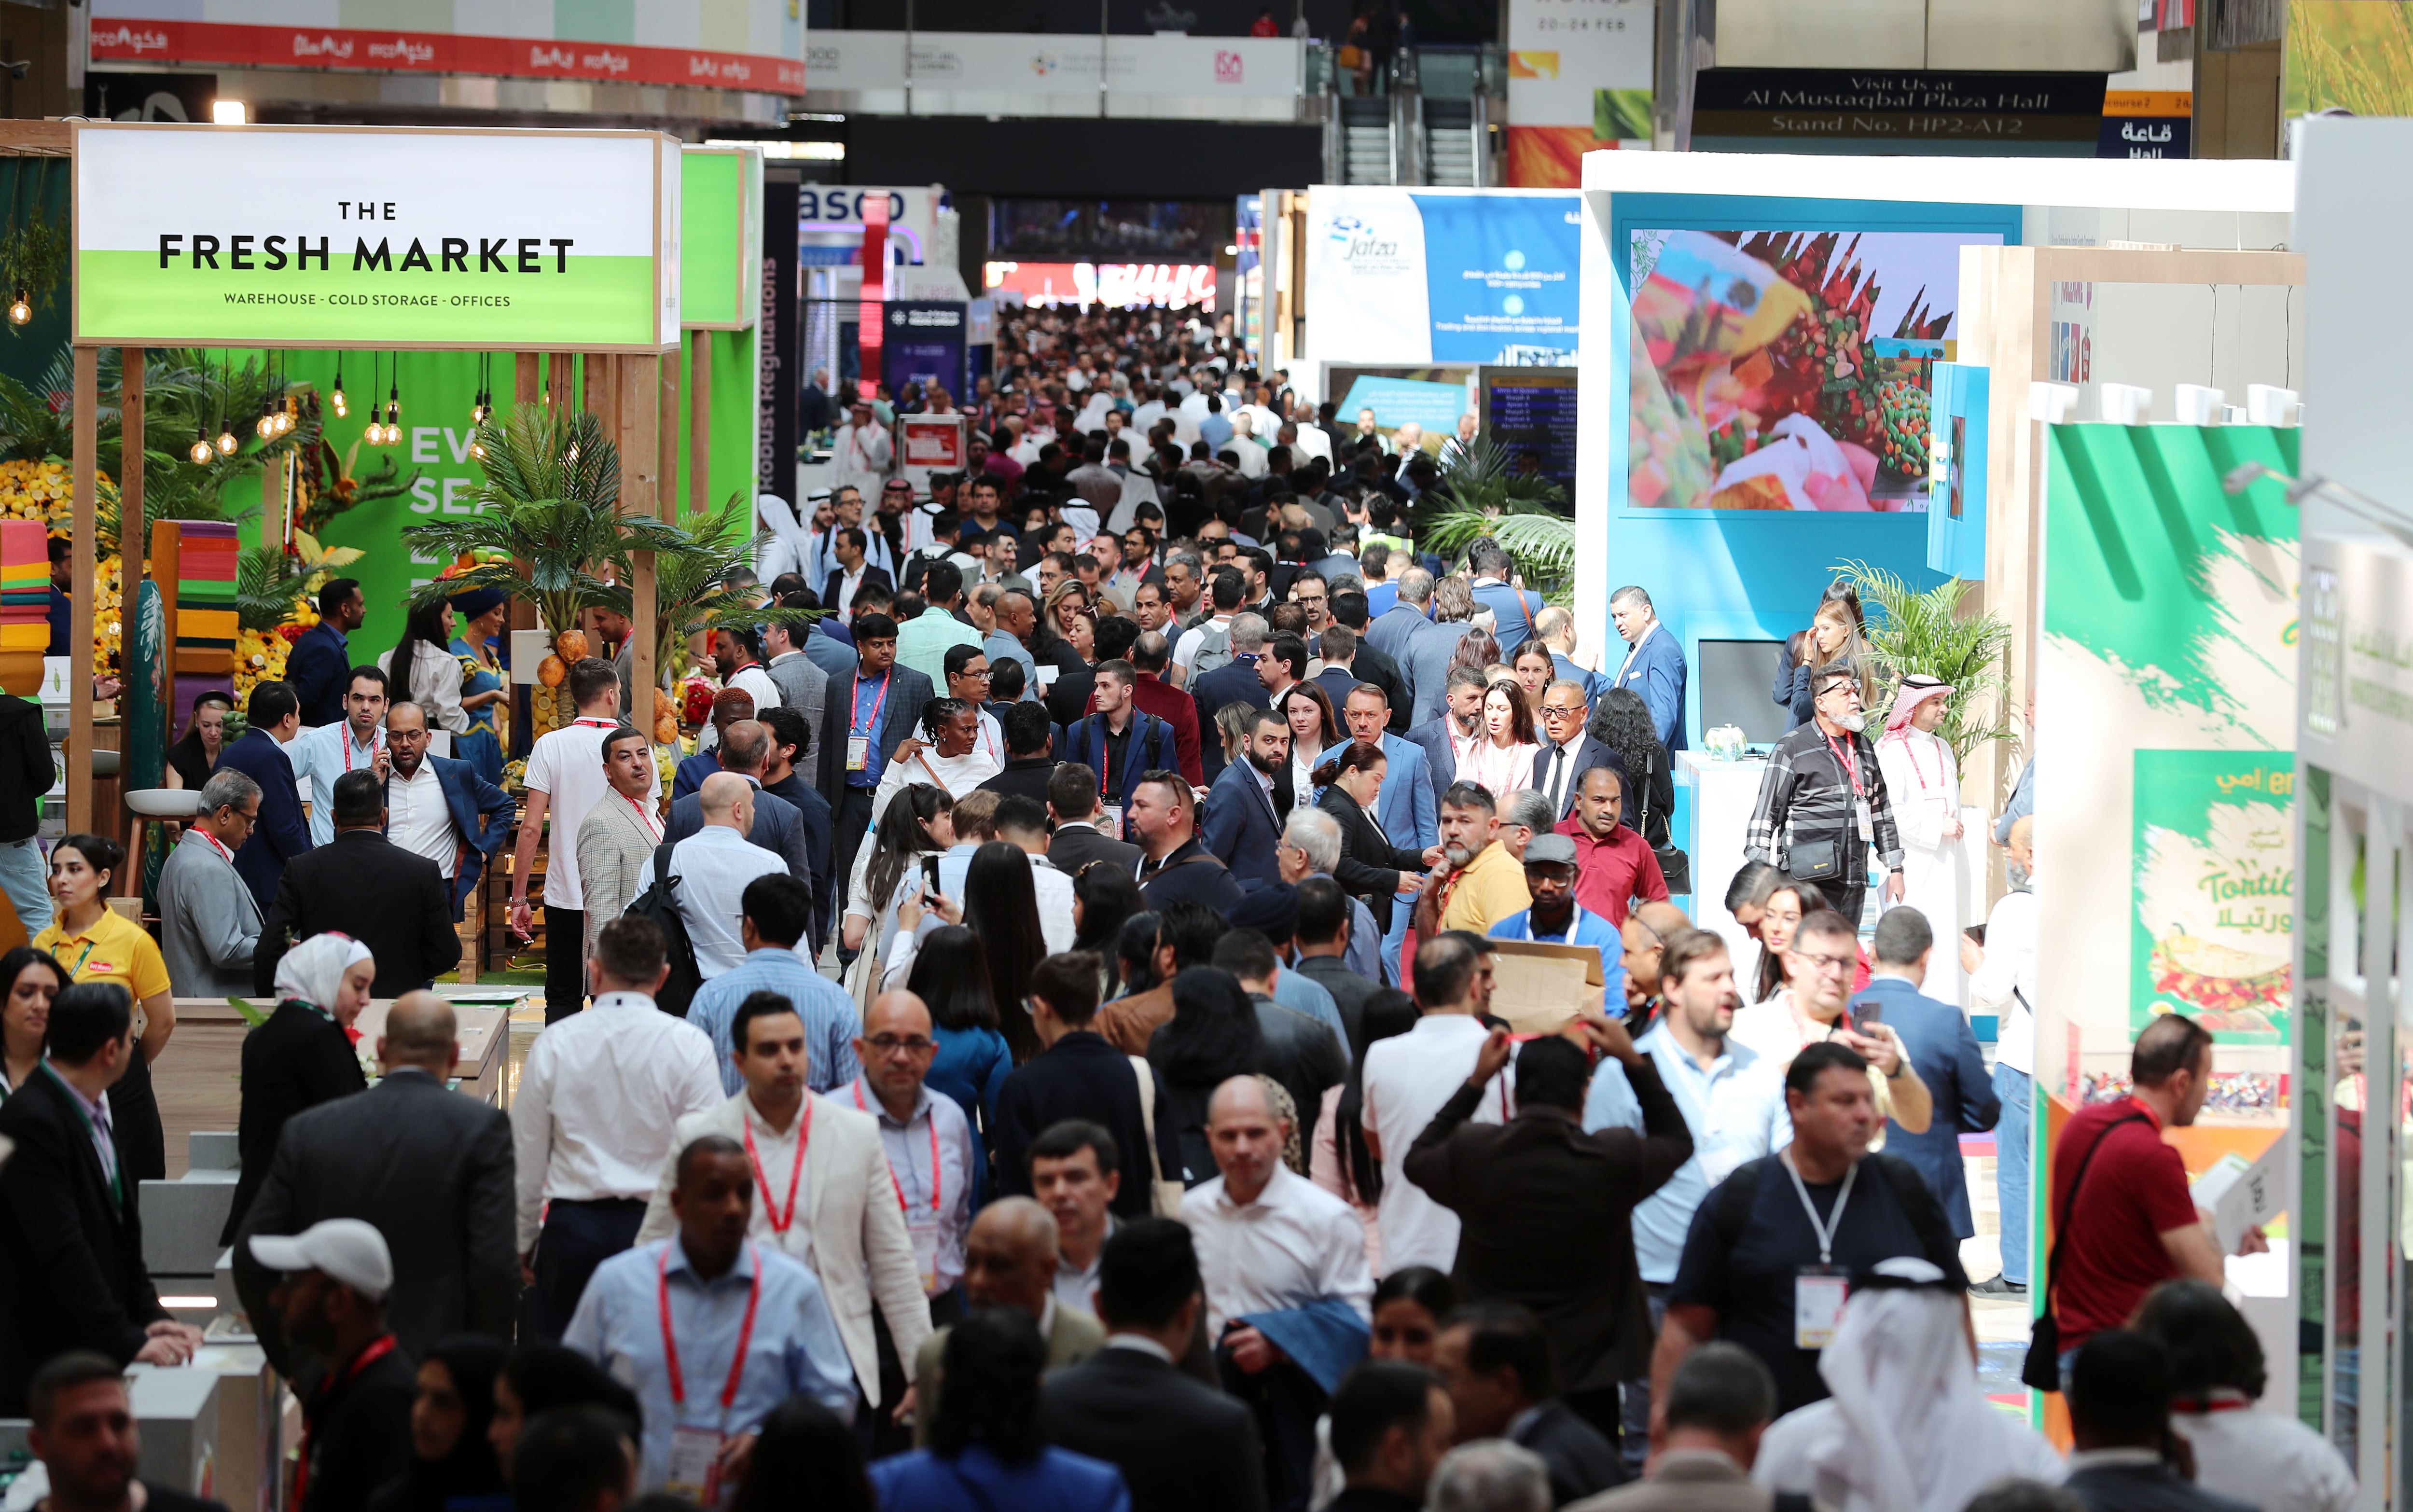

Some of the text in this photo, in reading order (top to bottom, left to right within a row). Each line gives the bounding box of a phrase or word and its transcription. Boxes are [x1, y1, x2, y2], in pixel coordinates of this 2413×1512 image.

[1852, 77, 1955, 92] Visit Us at
[1743, 89, 2049, 110] Al Mustaqbal Plaza Hall
[2104, 99, 2143, 108] course
[1772, 116, 2023, 134] Stand No. HP2-A12
[2121, 122, 2172, 142] قاعة
[338, 202, 396, 221] THE
[159, 234, 574, 274] FRESH MARKET
[224, 292, 316, 305] WAREHOUSE
[328, 295, 368, 306] COLD
[372, 295, 438, 306] STORAGE
[450, 296, 511, 307] OFFICES
[2217, 906, 2293, 934] ورتيلا
